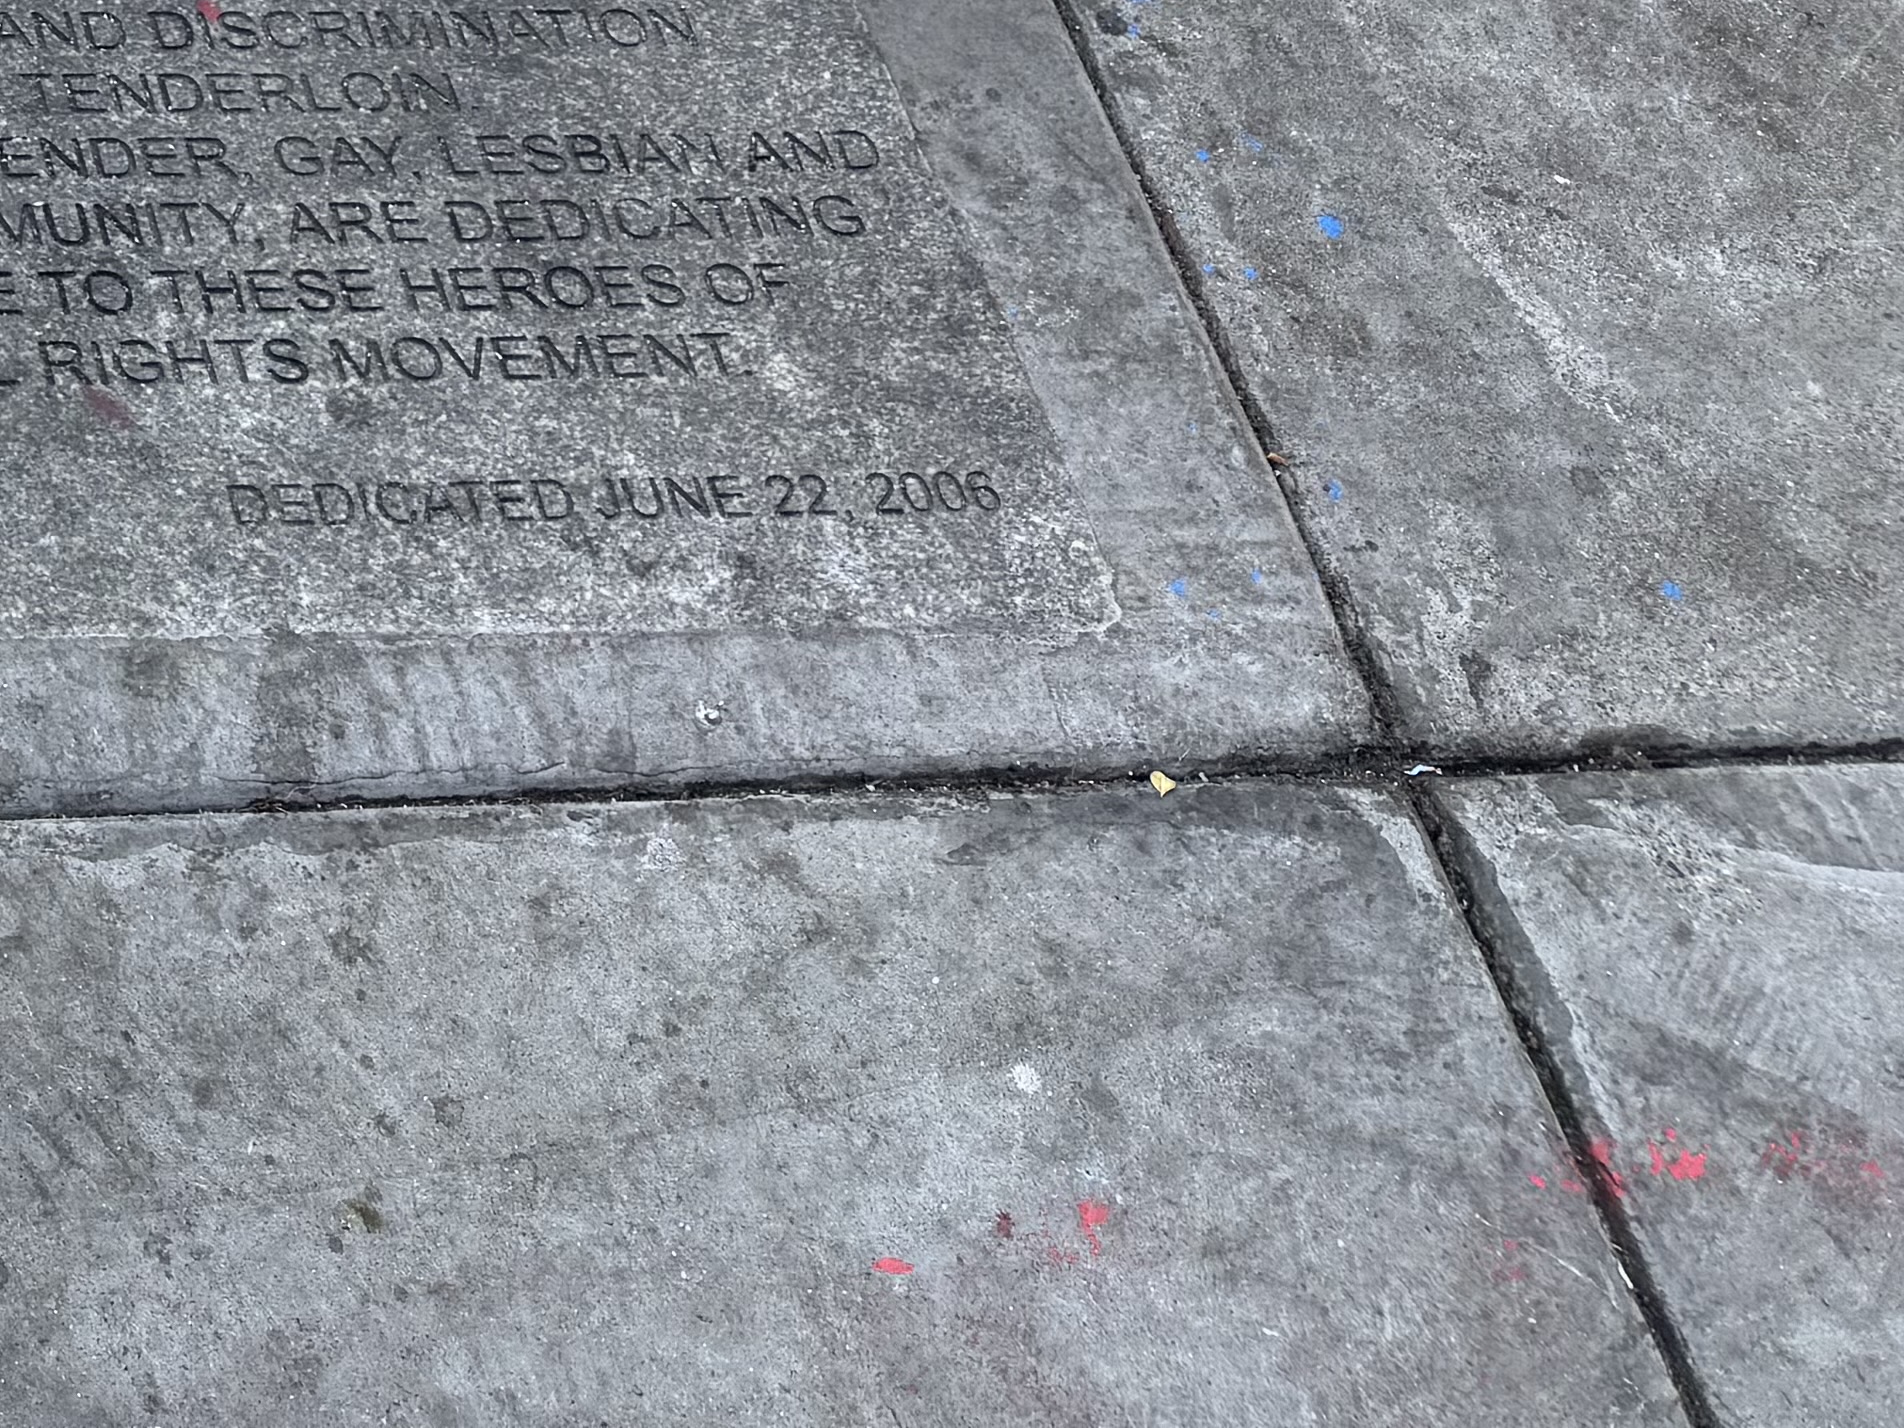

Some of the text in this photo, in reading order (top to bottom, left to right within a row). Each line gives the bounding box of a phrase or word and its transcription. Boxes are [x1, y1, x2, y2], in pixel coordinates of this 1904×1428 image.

[148, 8, 696, 48] DISCRIMINATION
[446, 133, 722, 175] LESBIAN
[747, 131, 880, 174] AND
[288, 201, 429, 243] ARE
[443, 196, 866, 243] DEDICATING
[36, 270, 135, 315] TO
[149, 268, 383, 315] THESE
[399, 264, 685, 312] HEROES
[705, 263, 790, 309] OF
[39, 338, 311, 387] RIGHTS
[225, 479, 574, 527] DEDICATED
[593, 476, 752, 519] JUNE
[866, 470, 1001, 515] 2006
